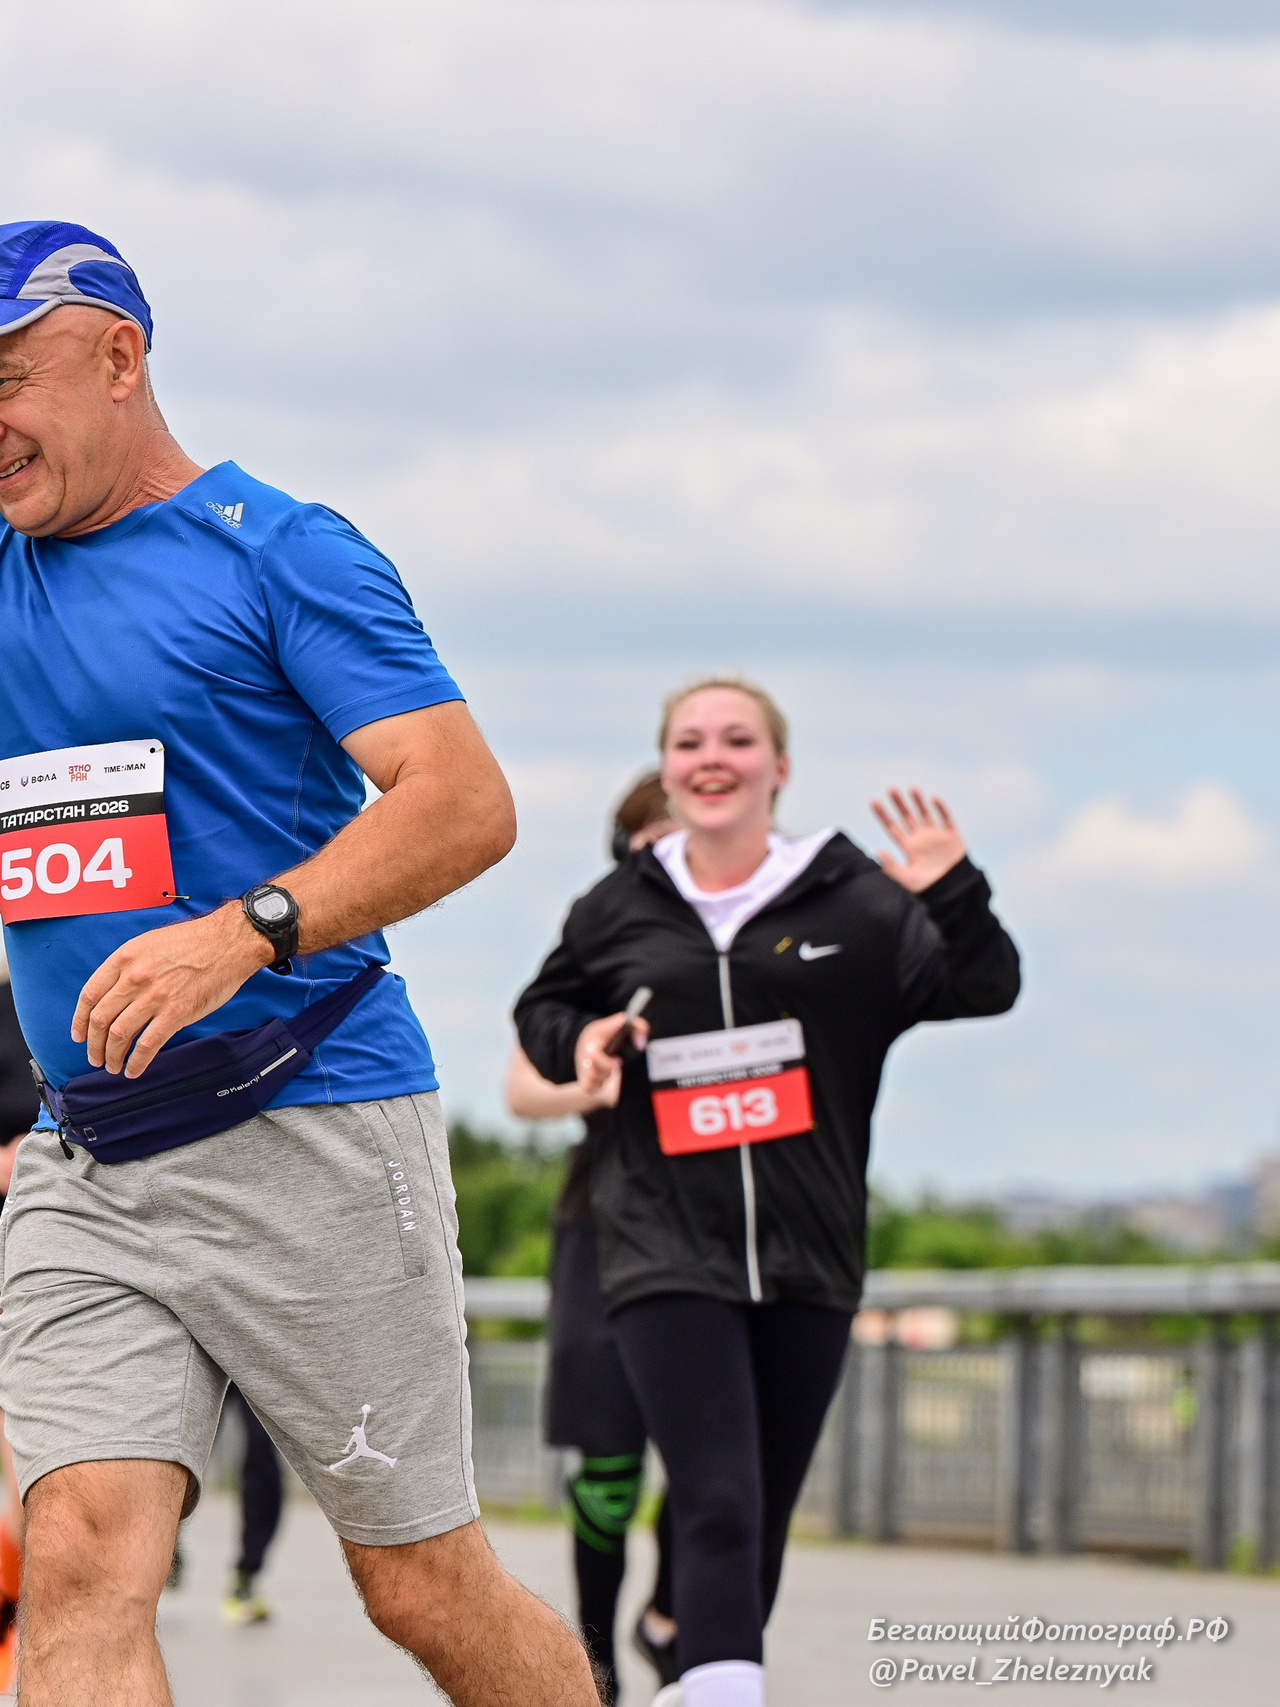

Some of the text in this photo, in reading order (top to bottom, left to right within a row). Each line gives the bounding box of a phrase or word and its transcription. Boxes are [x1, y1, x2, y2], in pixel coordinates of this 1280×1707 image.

[205, 501, 242, 530] adidas
[69, 764, 91, 776] ЭТНО
[0, 800, 130, 829] ТАТАРСТАН 2026
[0, 837, 133, 901] 504
[689, 1086, 779, 1136] 613
[388, 1160, 417, 1231] JORDAN
